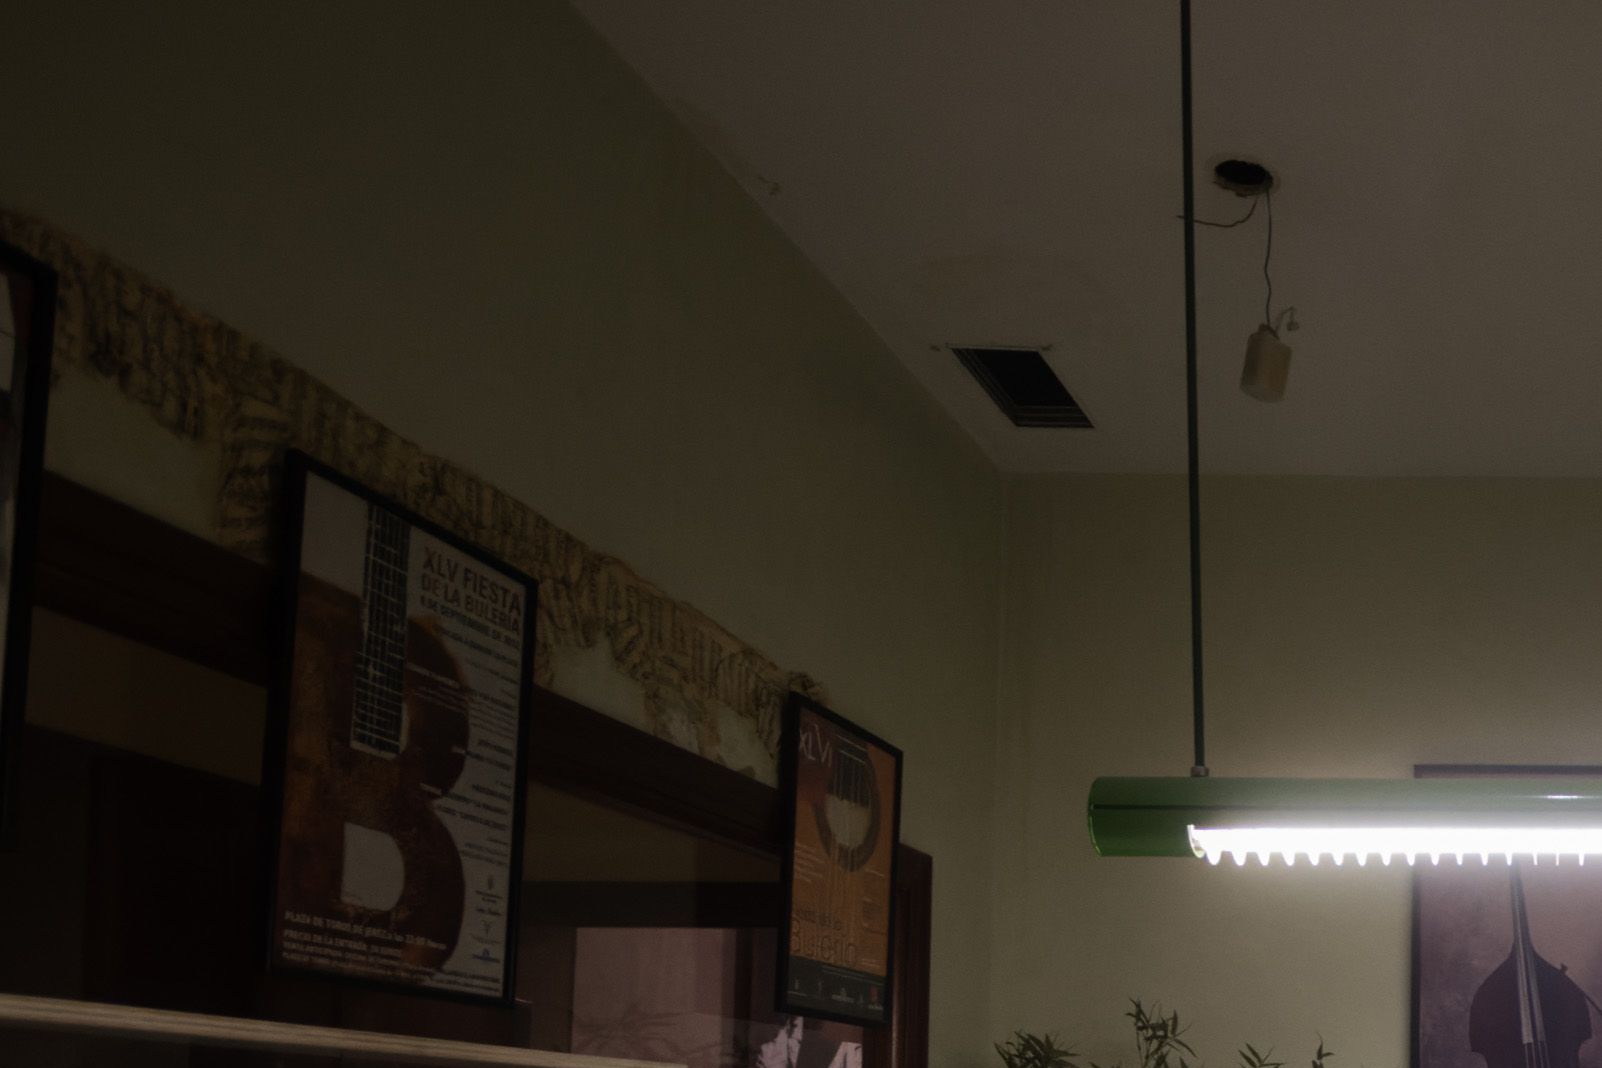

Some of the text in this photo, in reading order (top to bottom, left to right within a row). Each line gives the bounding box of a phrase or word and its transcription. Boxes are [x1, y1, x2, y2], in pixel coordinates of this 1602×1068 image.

[421, 572, 440, 598] DE
[444, 581, 460, 608] LA
[423, 546, 521, 617] XLV FIESTA
